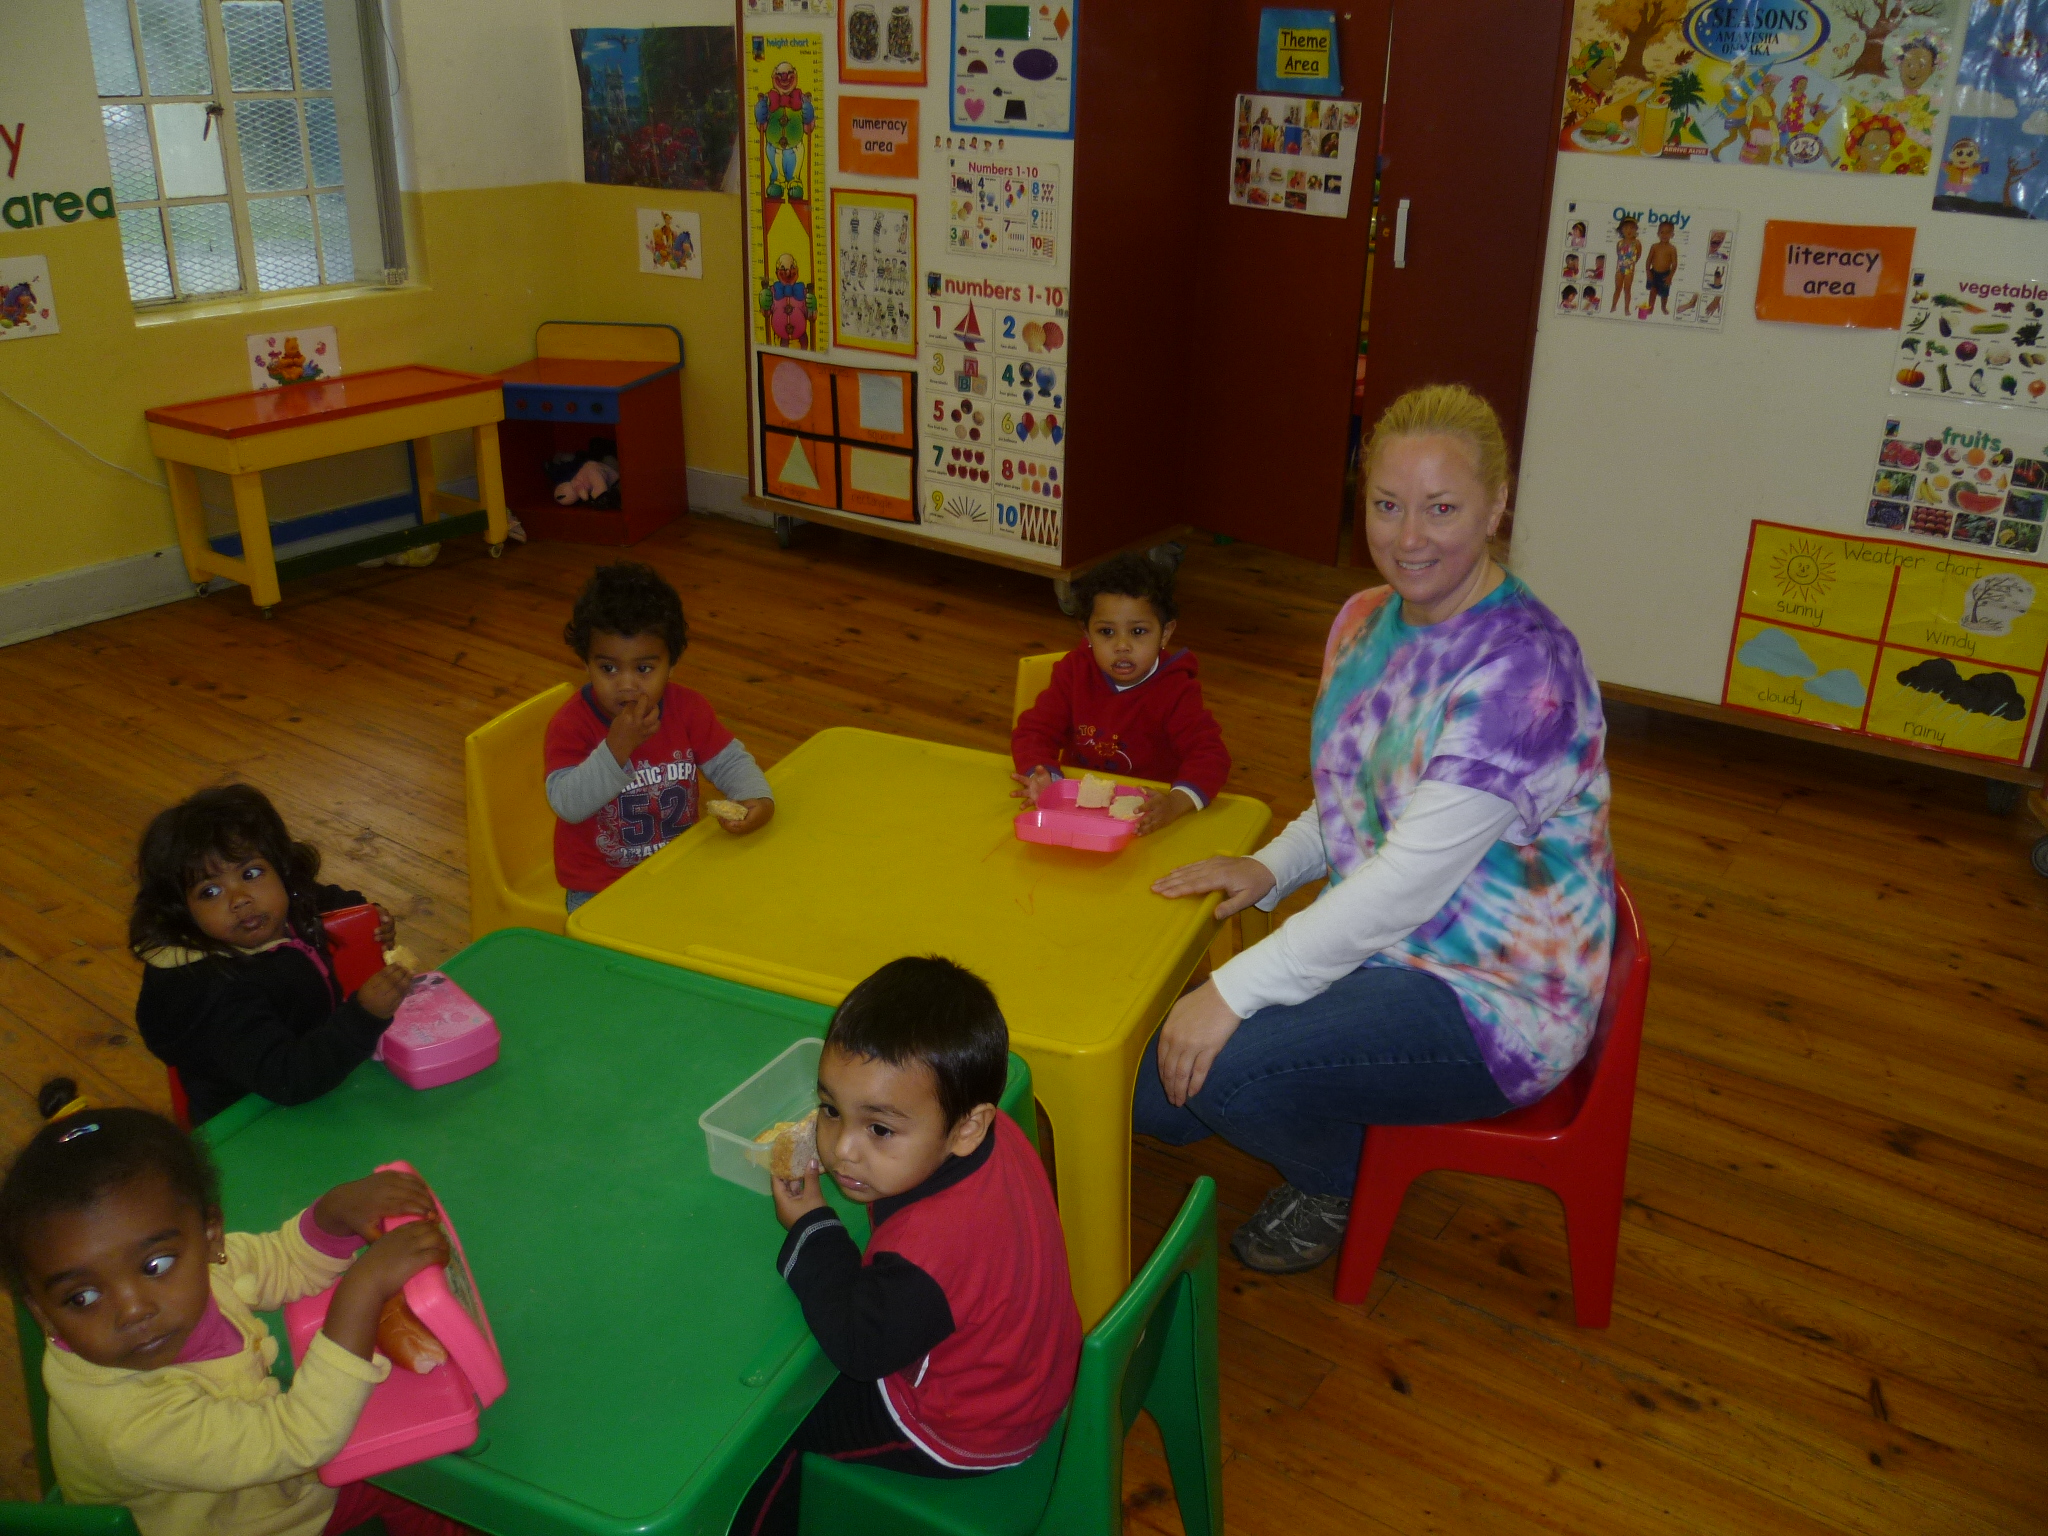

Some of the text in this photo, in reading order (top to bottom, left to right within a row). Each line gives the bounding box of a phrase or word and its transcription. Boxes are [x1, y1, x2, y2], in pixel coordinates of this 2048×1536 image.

[1712, 7, 1809, 31] SEASONS
[766, 37, 789, 50] height
[789, 37, 809, 48] chart
[1281, 31, 1328, 49] Theme
[1284, 55, 1320, 72] Area
[852, 117, 908, 135] numeracy
[864, 139, 893, 153] area
[968, 161, 1013, 176] Numbers
[951, 174, 957, 188] 1
[977, 176, 985, 190] 4
[1004, 180, 1012, 193] 6
[1031, 181, 1040, 196] 8
[2, 186, 117, 230] area
[1031, 209, 1039, 223] 9
[1612, 206, 1691, 230] Our body
[977, 214, 984, 230] 5
[1003, 219, 1011, 232] 7
[950, 227, 958, 240] 3
[1030, 236, 1043, 250] 10
[1787, 244, 1880, 273] literacy
[944, 278, 1022, 302] numbers
[1803, 279, 1856, 296] area
[932, 304, 942, 330] 1
[1002, 315, 1017, 340] 2
[932, 352, 945, 376] 3
[959, 377, 970, 392] B
[1001, 363, 1016, 388] 4
[932, 400, 945, 422] 5
[1001, 411, 1015, 435] 6
[1942, 426, 2003, 453] fruits
[932, 444, 944, 467] 7
[1001, 458, 1014, 481] 8
[931, 490, 945, 512] 9
[996, 502, 1019, 528] 10
[1843, 541, 1983, 579] Weather chart
[1776, 600, 1824, 627] sunny
[1757, 688, 1804, 715] cloudy
[1903, 719, 1947, 747] rainy
[619, 784, 695, 846] 52
